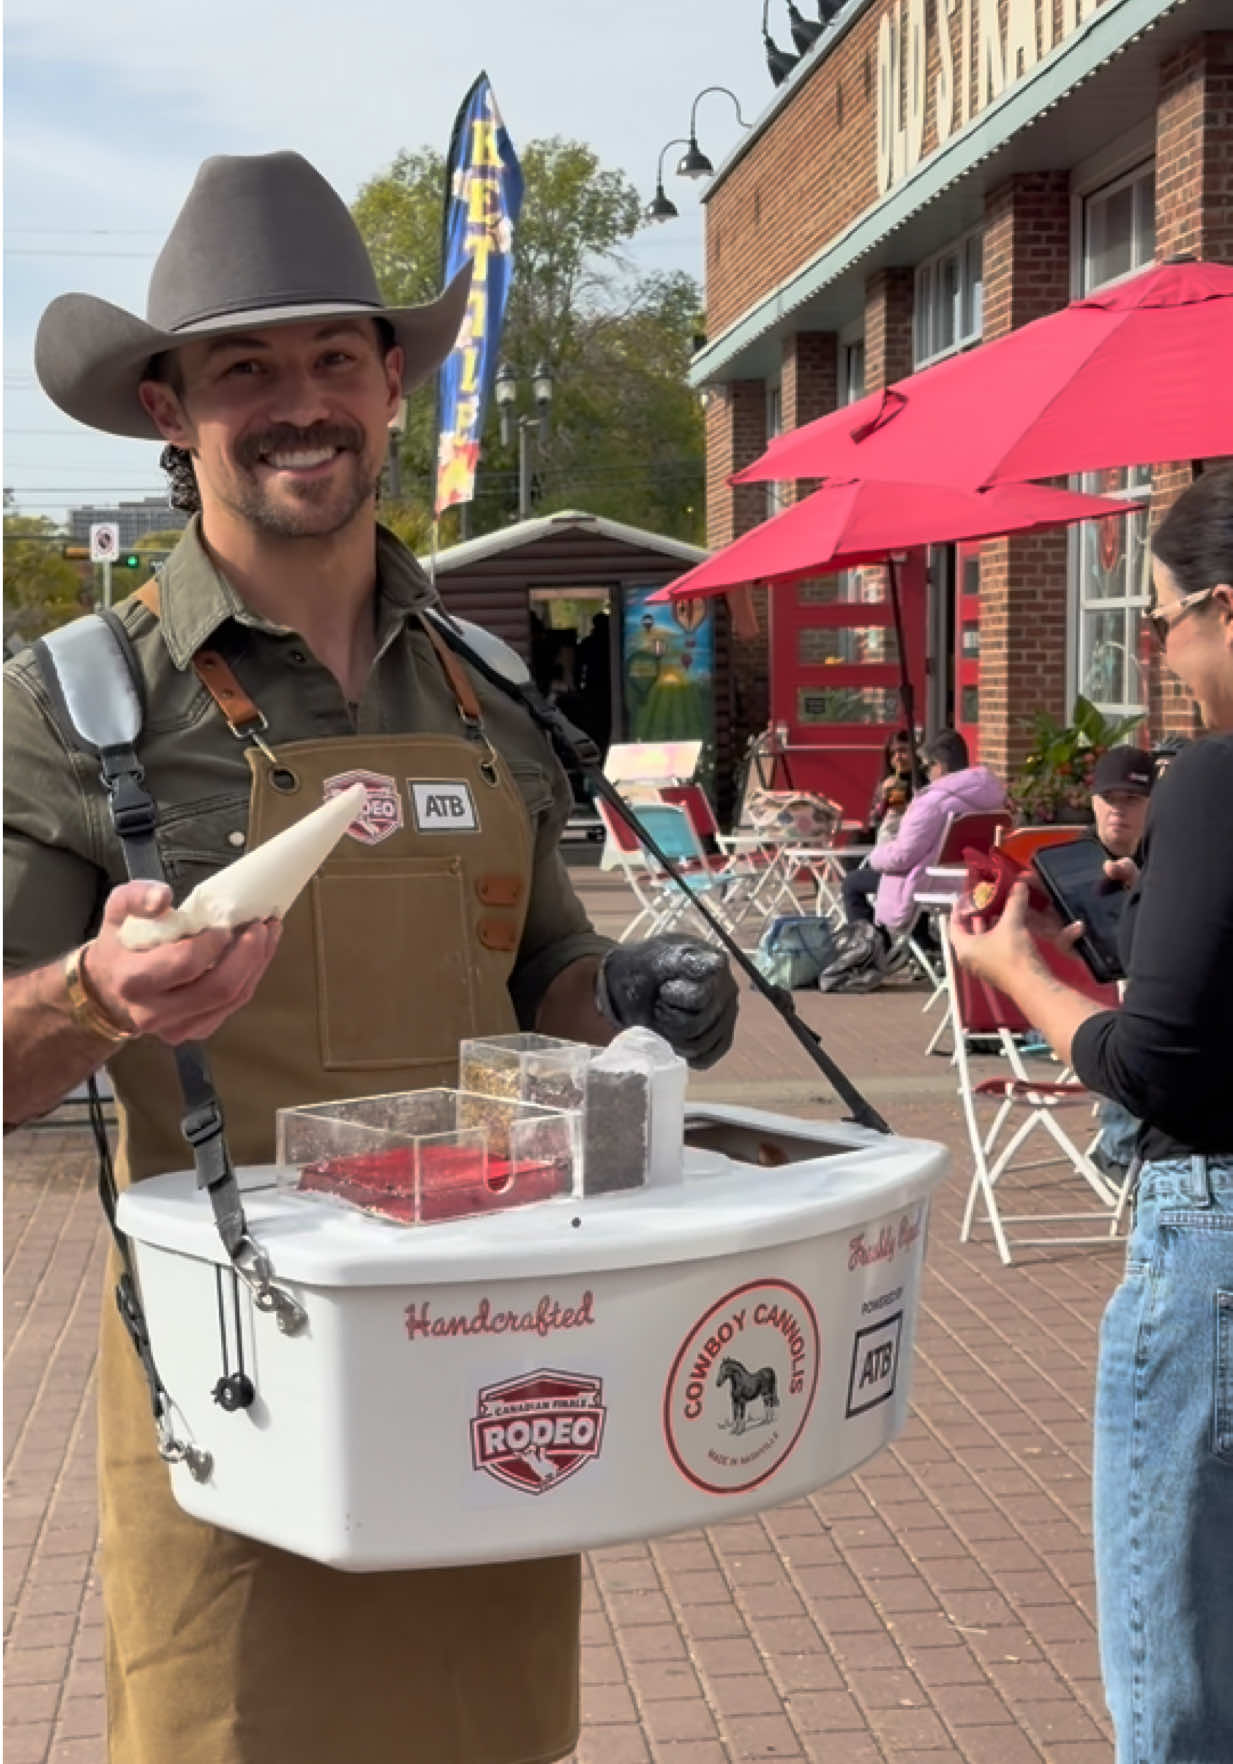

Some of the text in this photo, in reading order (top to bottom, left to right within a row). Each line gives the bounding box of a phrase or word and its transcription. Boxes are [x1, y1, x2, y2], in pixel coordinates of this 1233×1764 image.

[877, 0, 927, 198] OLD
[425, 795, 465, 817] ATB
[404, 1290, 594, 1340] Handcrafted
[684, 1303, 806, 1420] COWBOY CANNOLIS
[859, 1341, 893, 1389] ATB
[495, 1402, 549, 1417] CANADIAN
[484, 1416, 595, 1455] RODEO
[708, 1448, 728, 1466] MADE
